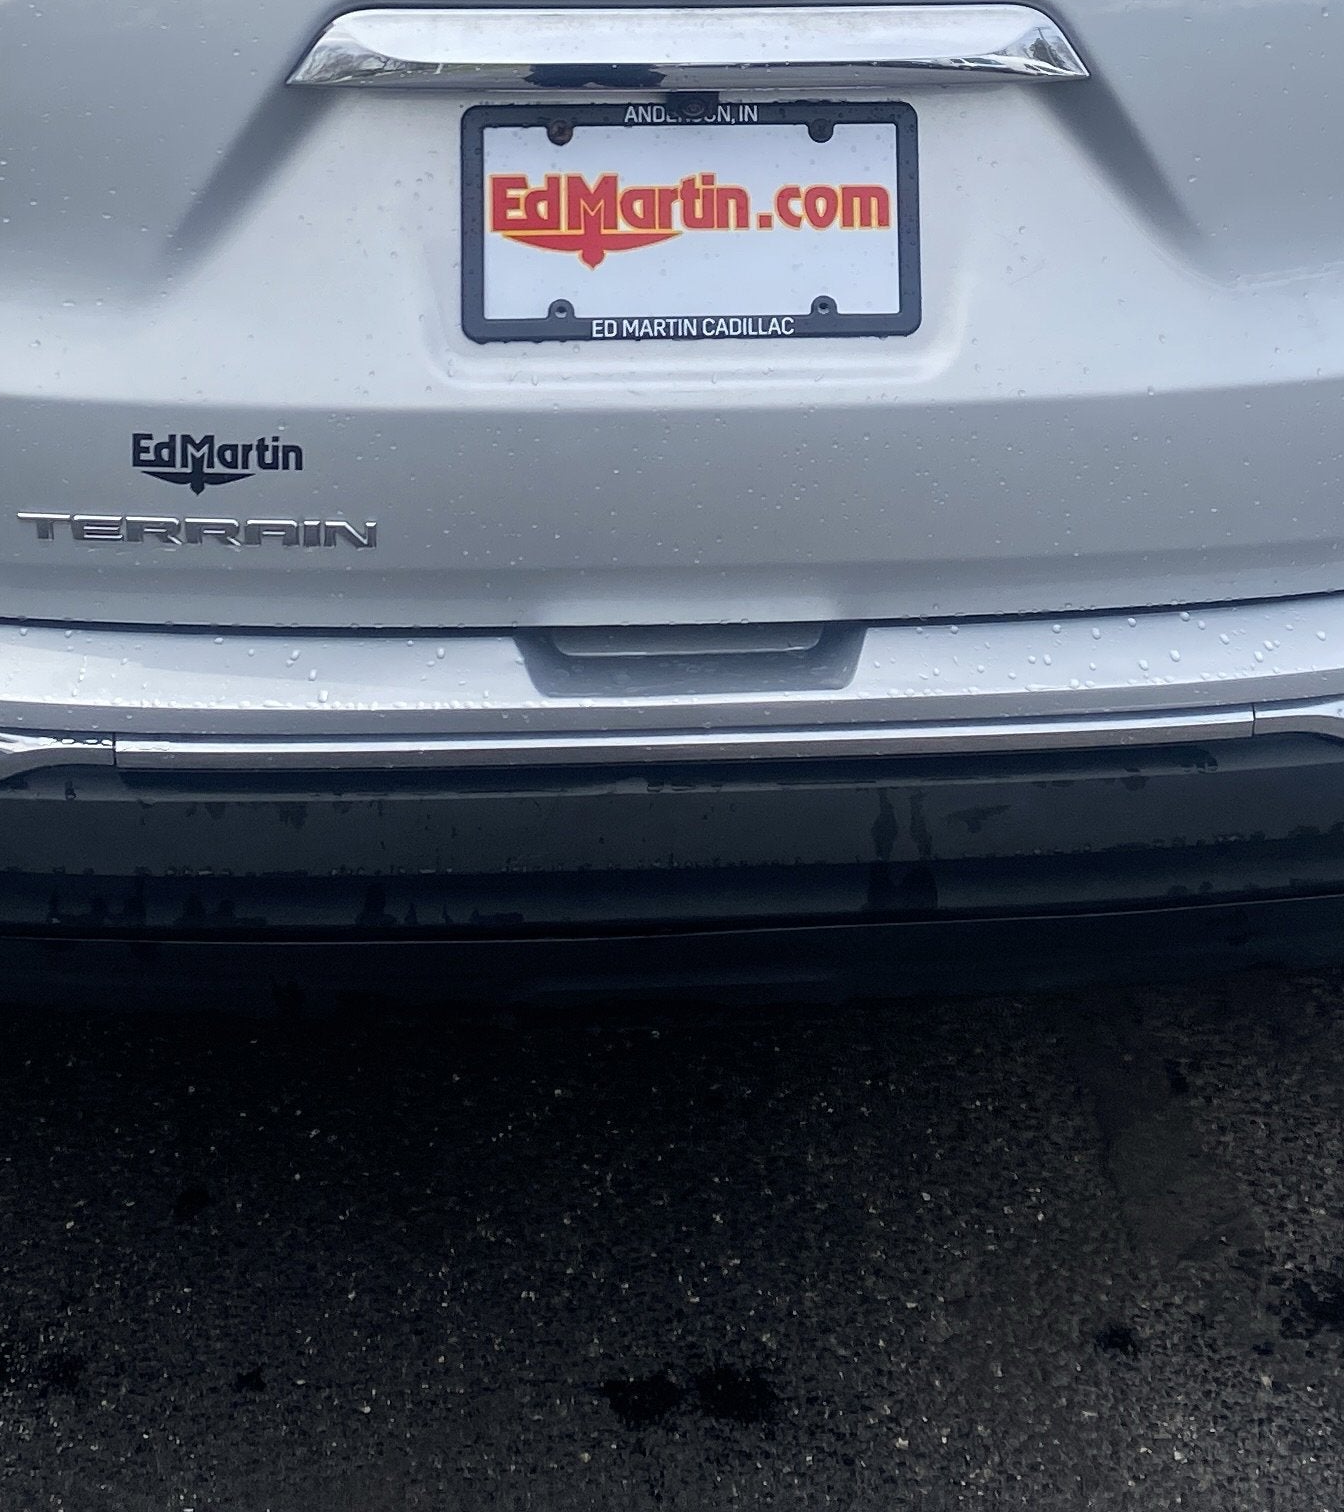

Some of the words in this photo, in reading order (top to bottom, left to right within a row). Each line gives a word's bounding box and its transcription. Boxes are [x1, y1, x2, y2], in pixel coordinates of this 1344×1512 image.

[739, 105, 758, 122] IN
[488, 172, 891, 232] EdMartin.com
[591, 319, 618, 338] ED
[622, 318, 697, 338] MARTIN
[702, 317, 795, 336] CADILLAC
[131, 433, 303, 471] EdMartin
[17, 511, 377, 548] TERRAIN
